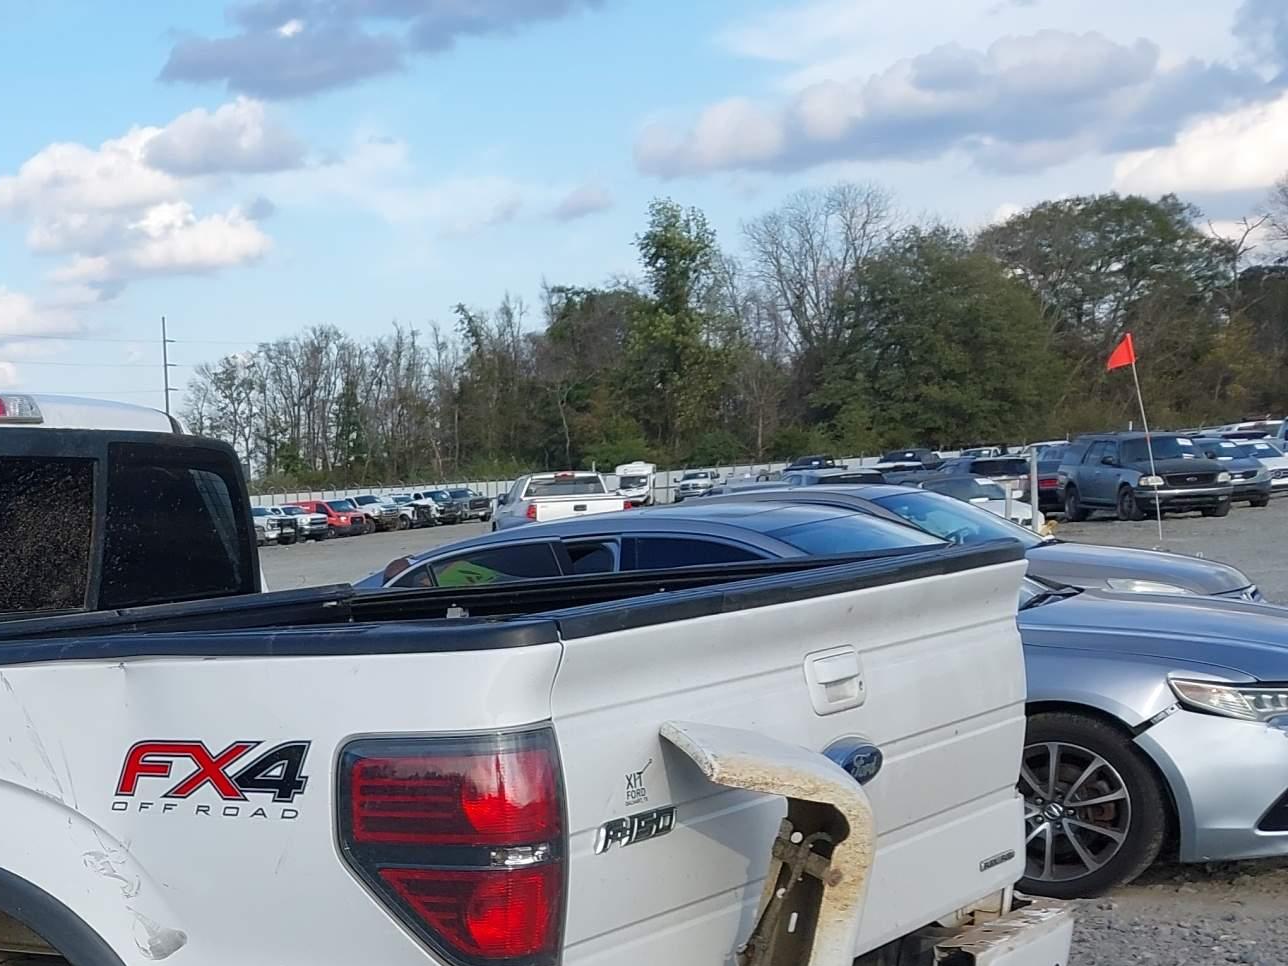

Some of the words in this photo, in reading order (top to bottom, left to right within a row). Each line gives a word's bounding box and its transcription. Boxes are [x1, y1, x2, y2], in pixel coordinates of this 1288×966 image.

[115, 740, 312, 803] FX4
[624, 771, 644, 790] XIT
[626, 787, 647, 800] FORD
[111, 801, 178, 814] OFF
[195, 805, 300, 819] ROAD
